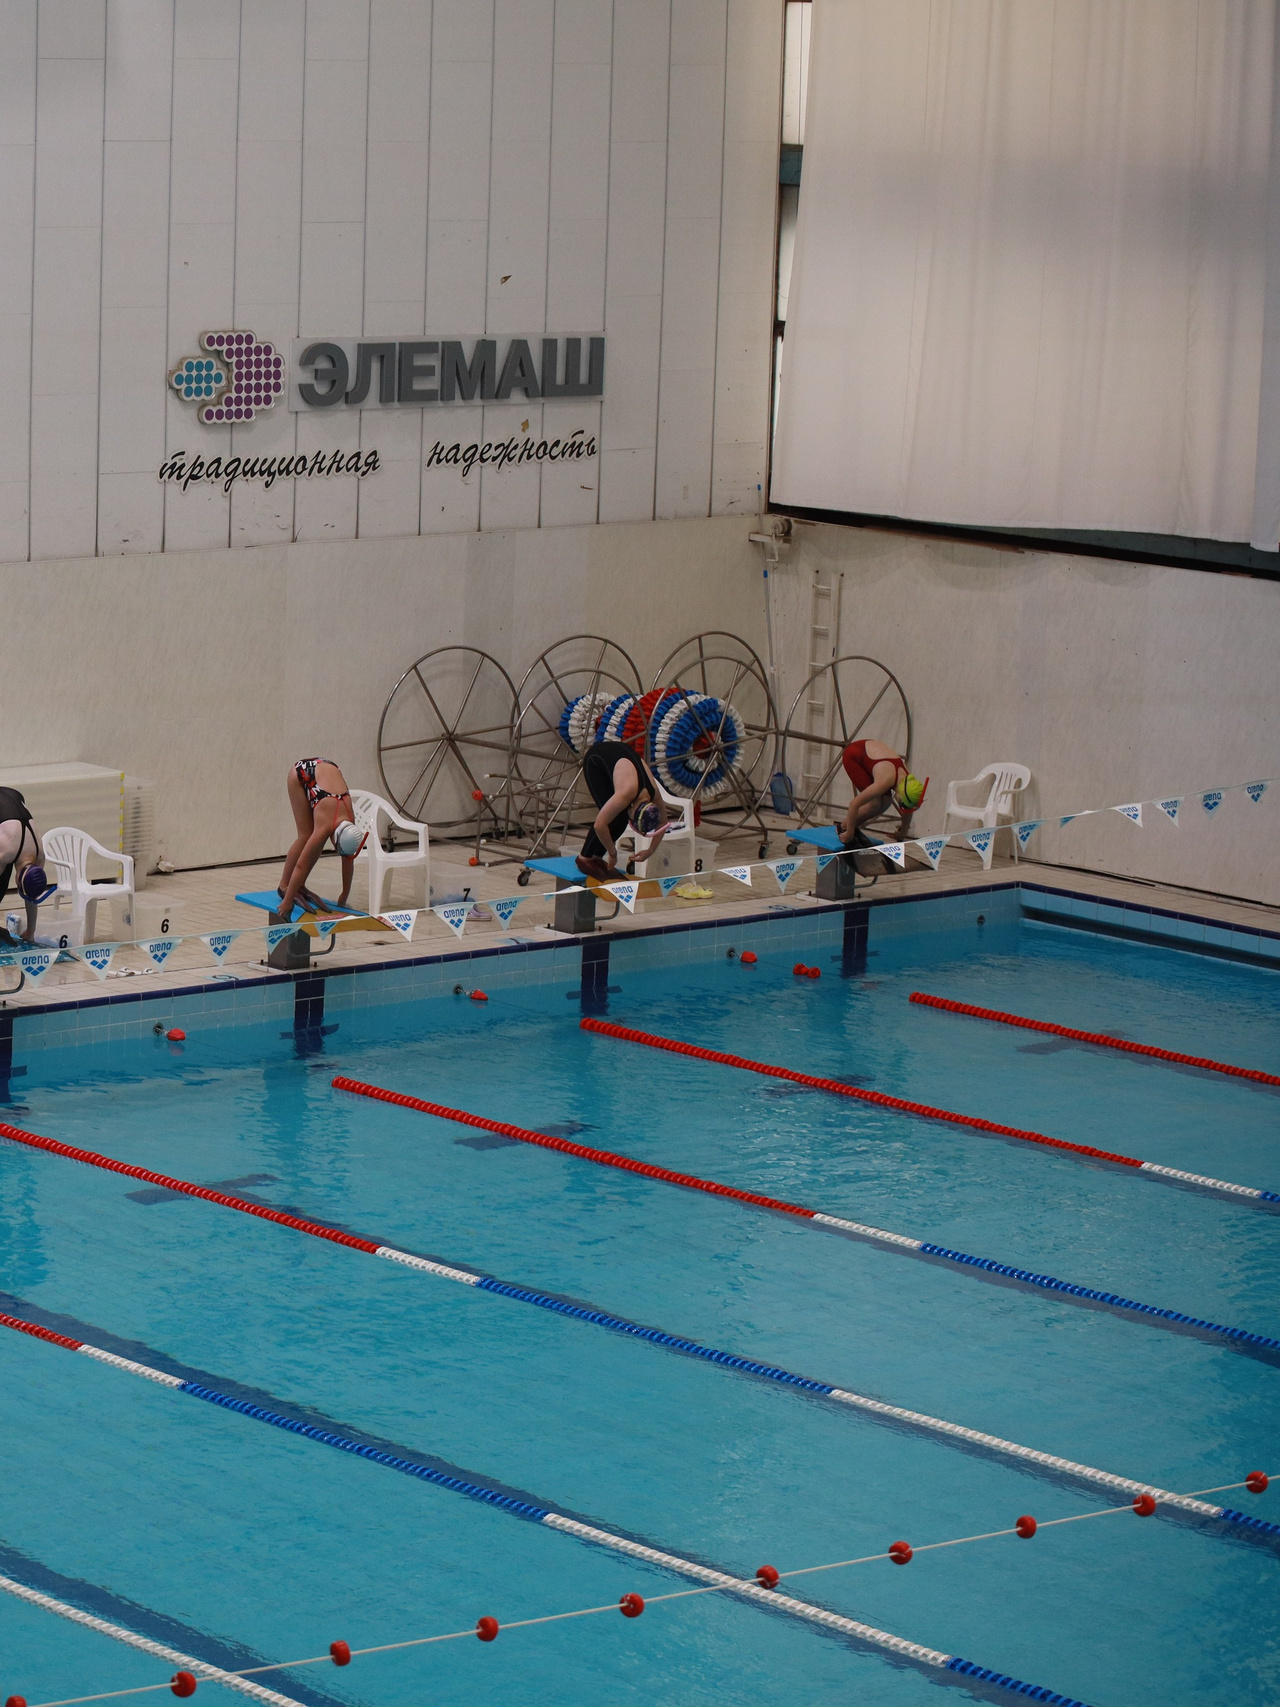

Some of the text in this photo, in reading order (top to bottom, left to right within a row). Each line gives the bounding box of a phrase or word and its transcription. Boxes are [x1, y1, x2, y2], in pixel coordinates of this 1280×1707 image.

[298, 336, 605, 407] ЭЛЕМАШ
[159, 430, 597, 493] традиционная надежность
[971, 832, 991, 843] arena
[925, 840, 943, 851] arena
[695, 859, 702, 872] 8
[776, 863, 795, 873] arena
[463, 888, 471, 902] 7
[496, 900, 517, 912] arena
[388, 913, 412, 922] arena
[443, 908, 465, 919] arena
[161, 918, 170, 933] 6
[268, 927, 291, 939] arena
[59, 935, 68, 949] 6
[209, 935, 231, 947] arena
[85, 948, 111, 959] arena
[149, 942, 172, 953] arena
[21, 955, 50, 965] arena
